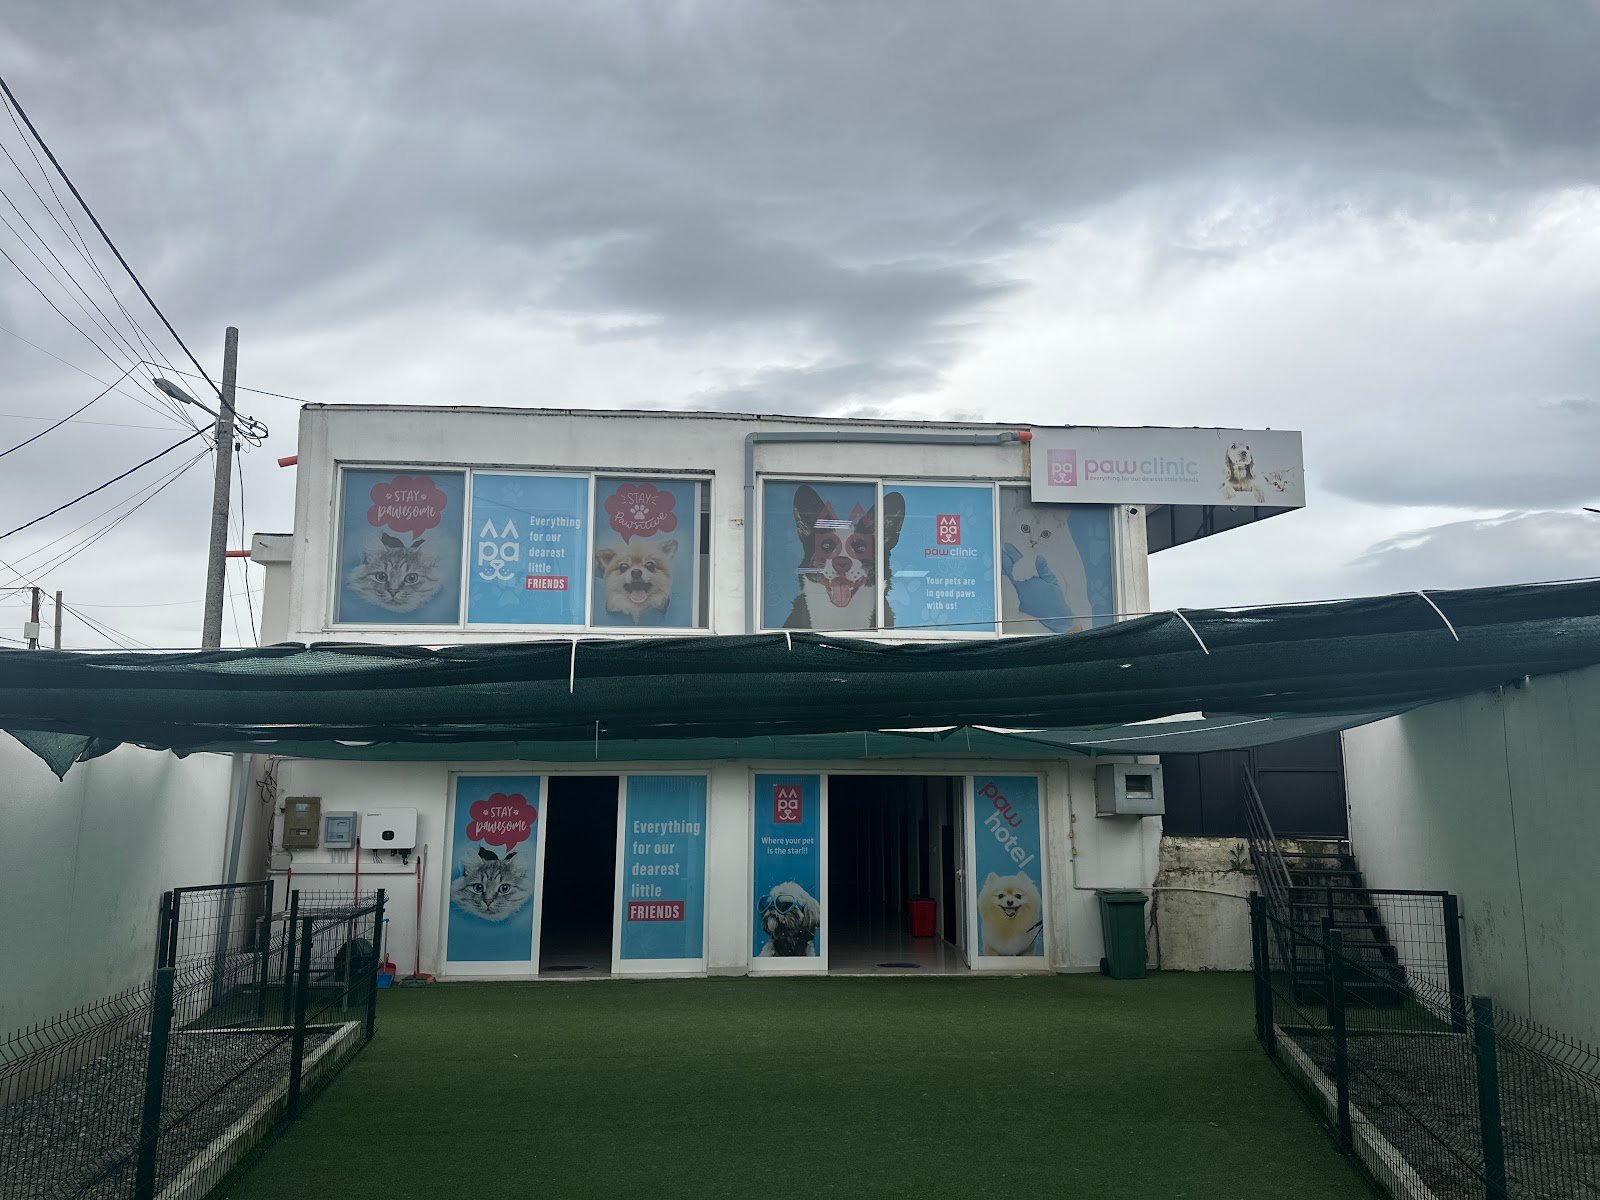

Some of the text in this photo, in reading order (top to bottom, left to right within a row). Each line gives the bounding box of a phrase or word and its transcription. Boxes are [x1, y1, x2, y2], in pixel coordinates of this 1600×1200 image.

[1084, 457, 1198, 480] paw clinic
[394, 490, 420, 502] STAY
[627, 492, 652, 504] STAY
[377, 504, 436, 520] pawesome
[529, 515, 581, 530] Everything
[614, 511, 668, 530] Pawsitive
[529, 531, 561, 543] for our
[528, 547, 565, 558] dearest
[924, 547, 978, 559] paw clinic
[527, 562, 552, 574] little
[527, 578, 565, 590] FRIENDS
[926, 577, 976, 587] Your pets are
[936, 588, 954, 599] good
[955, 590, 976, 599] paws
[926, 601, 958, 610] with us!
[978, 781, 1023, 828] paw
[490, 806, 513, 818] STAY
[475, 818, 528, 836] pawesome
[633, 820, 701, 836] Everything
[761, 836, 814, 846] Where your pet
[984, 810, 1035, 869] hotel
[632, 841, 675, 855] for our
[631, 862, 680, 876] dearest
[631, 883, 662, 898] little
[630, 905, 680, 919] FRIENDS
